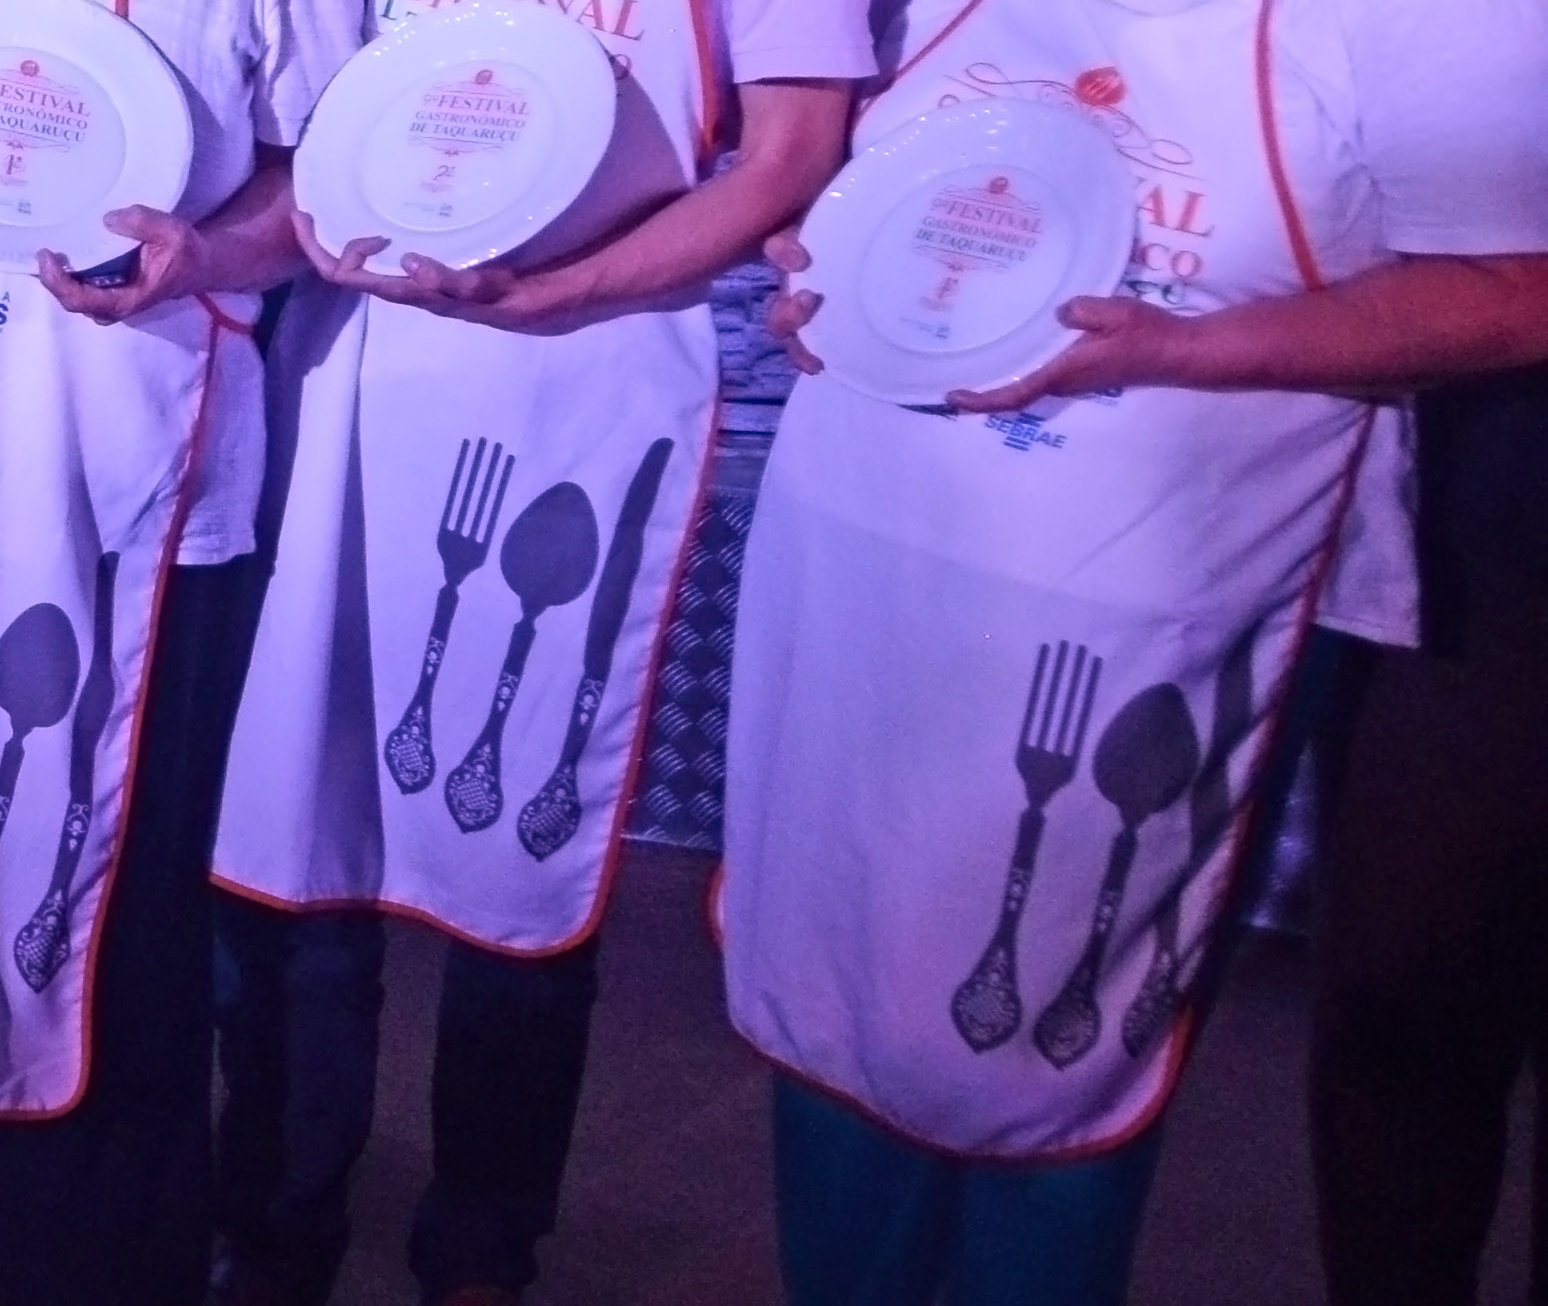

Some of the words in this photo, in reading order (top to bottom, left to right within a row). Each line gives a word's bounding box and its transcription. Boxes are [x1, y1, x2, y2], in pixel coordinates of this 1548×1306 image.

[438, 95, 529, 115] FESTIVAL
[409, 122, 427, 133] DE
[947, 200, 1042, 234] FESTIVAL
[916, 228, 935, 241] DE
[984, 414, 1067, 449] SEBRAE
